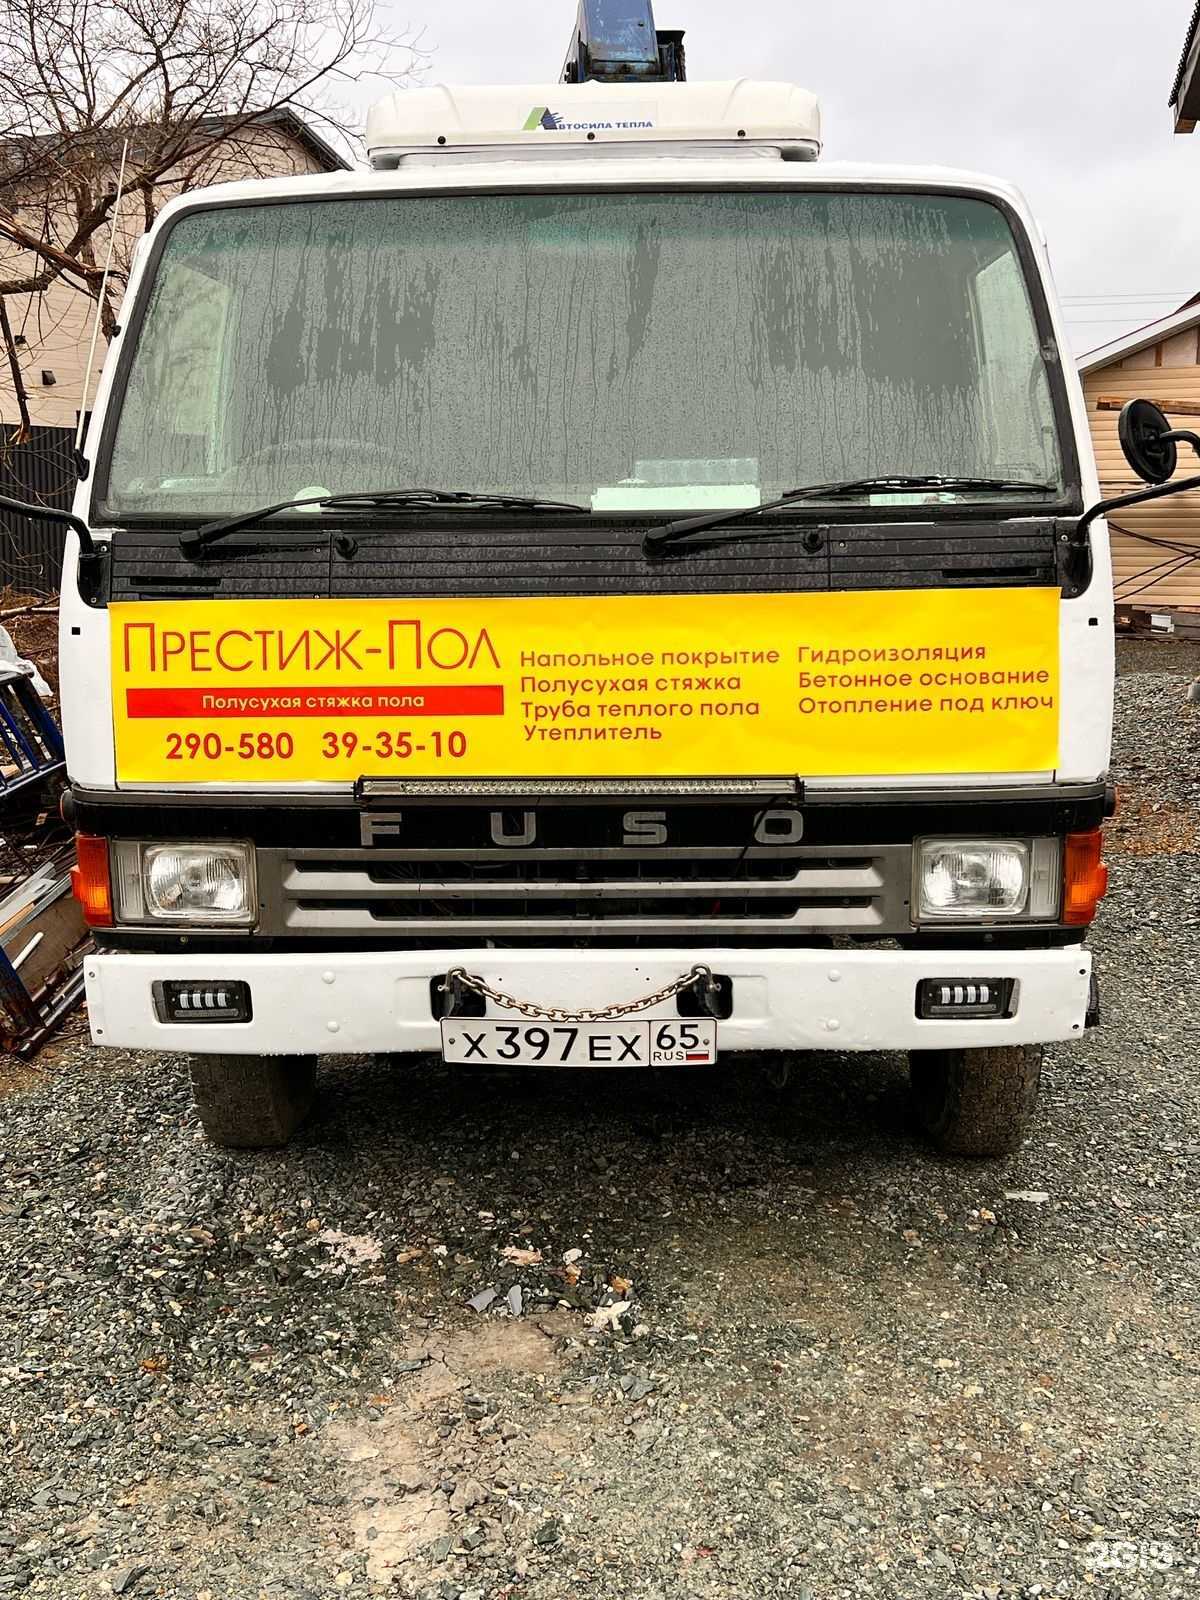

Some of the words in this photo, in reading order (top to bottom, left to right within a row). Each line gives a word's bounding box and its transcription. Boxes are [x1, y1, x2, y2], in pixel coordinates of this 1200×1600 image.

[520, 650, 655, 667] Напольное
[661, 650, 780, 668] покрытие
[798, 647, 986, 665] Гидроизоляция
[520, 677, 648, 695] Полусухая
[655, 676, 741, 691] стяжка
[799, 672, 913, 688] Бетонное
[919, 670, 1049, 686] основание
[202, 695, 301, 711] Полусухая
[305, 696, 373, 708] стяжка
[377, 695, 425, 708] пола
[521, 700, 590, 721] Труба
[597, 703, 694, 718] теплого
[700, 702, 760, 716] пола
[799, 697, 933, 714] Отопление
[940, 697, 985, 712] под
[991, 696, 1053, 710] ключ
[524, 725, 663, 741] Утеплитель
[165, 732, 294, 760] 290-580
[322, 731, 467, 759] 39-35-10
[360, 810, 804, 846] FUSO
[656, 1024, 699, 1050] 65
[653, 1051, 684, 1061] RUS
